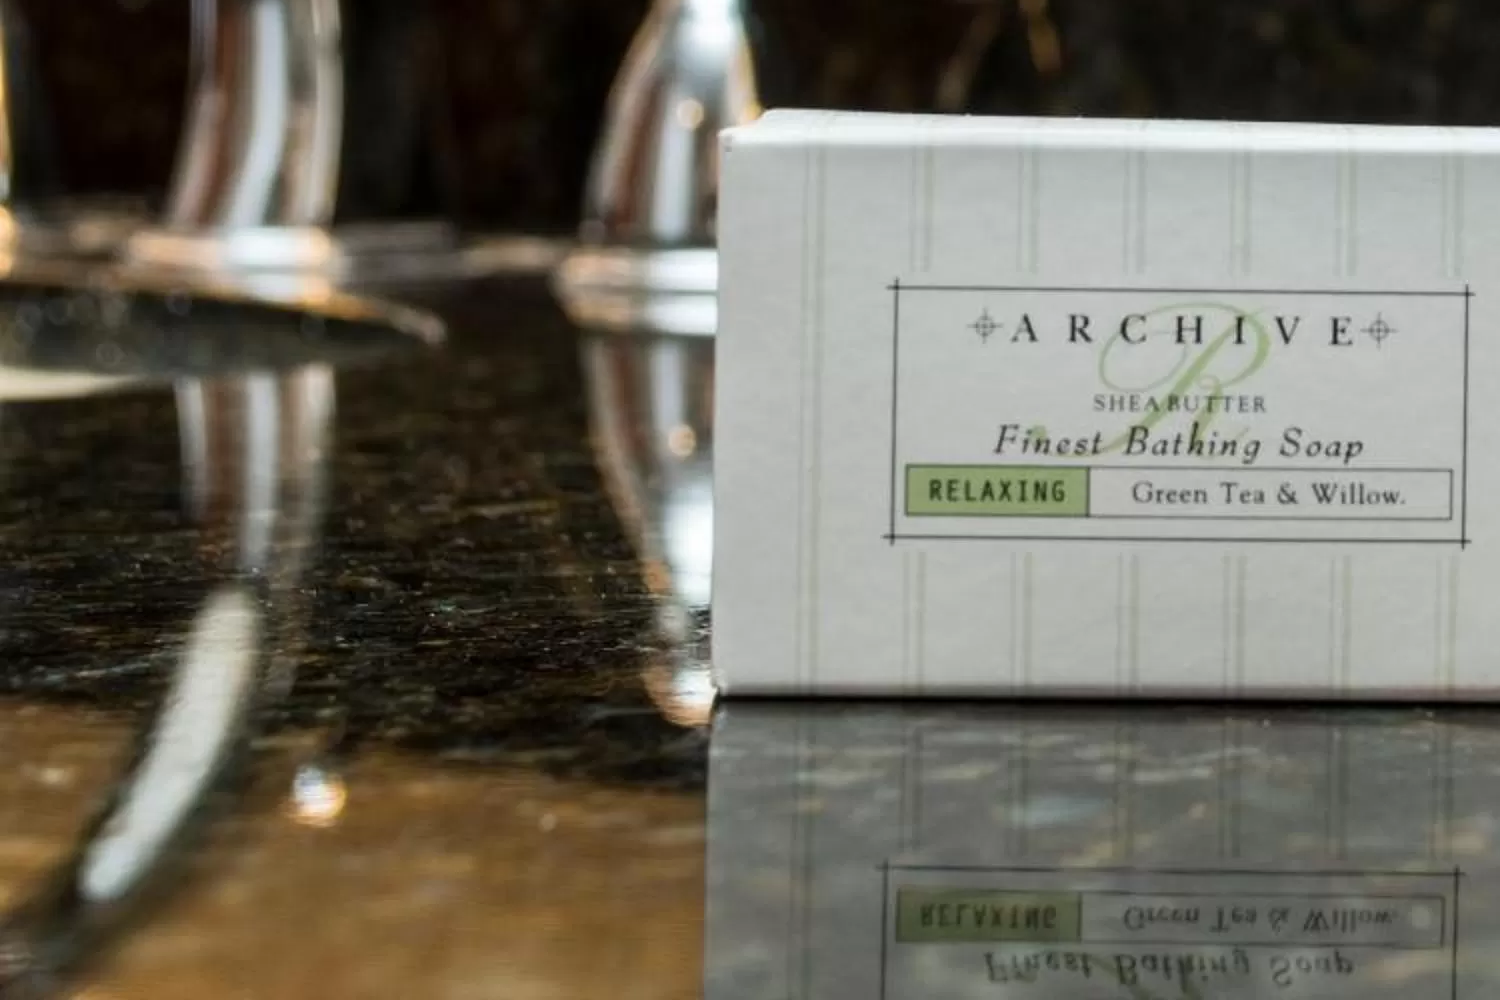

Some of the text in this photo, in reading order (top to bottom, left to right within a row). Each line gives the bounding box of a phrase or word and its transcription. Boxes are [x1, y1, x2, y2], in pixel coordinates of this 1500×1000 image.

[1011, 314, 1353, 346] ARCHIVE
[994, 420, 1363, 465] Finest Bathing Soap
[929, 479, 1066, 502] RELAXING
[1132, 481, 1406, 506] Green Tea & Willow.
